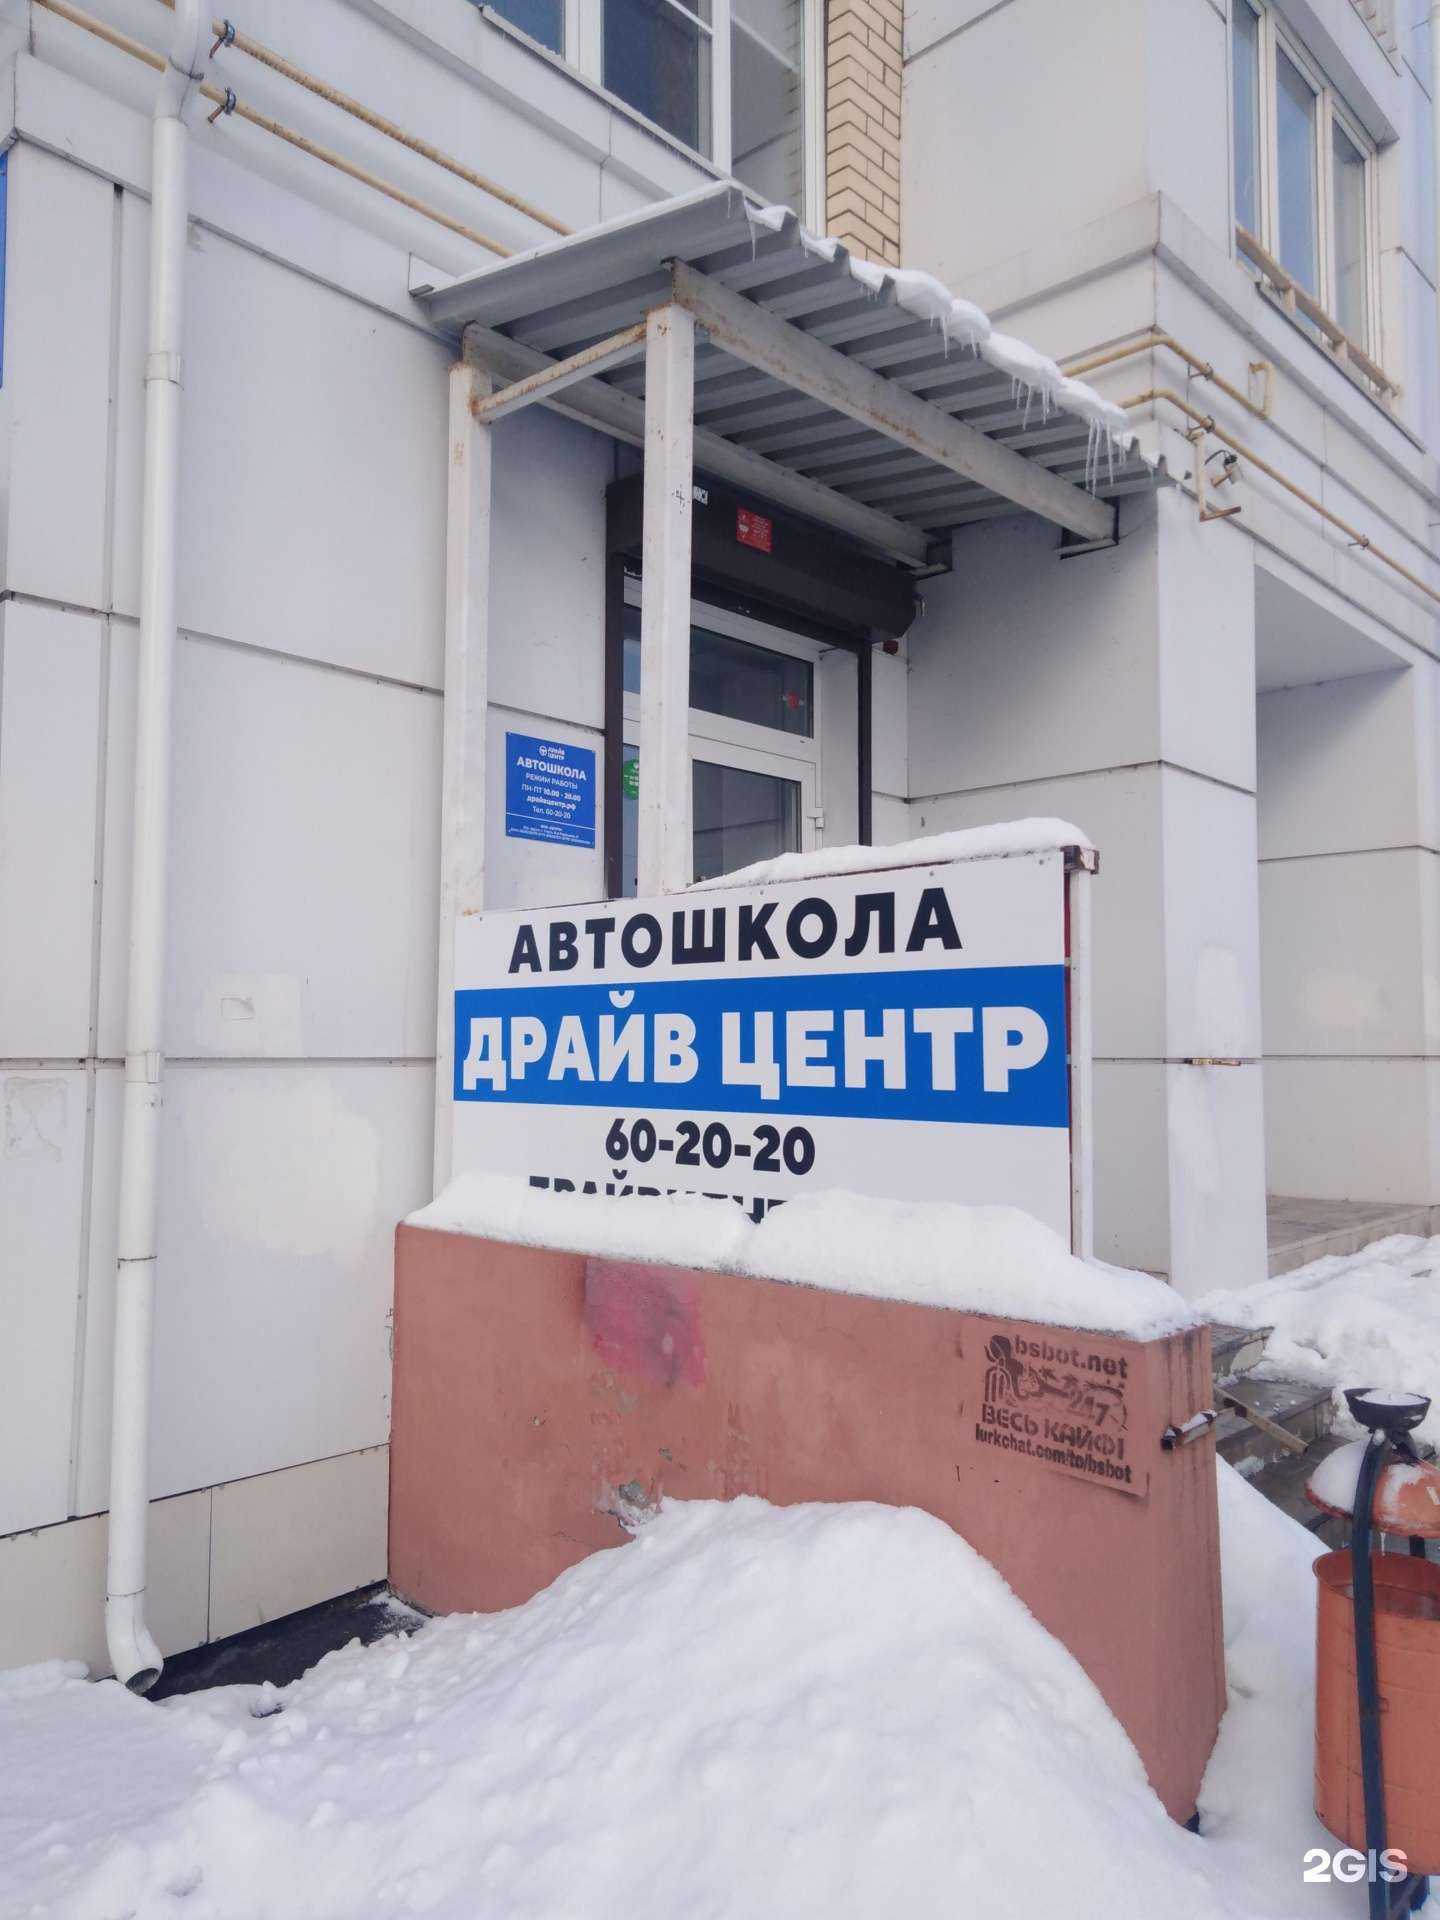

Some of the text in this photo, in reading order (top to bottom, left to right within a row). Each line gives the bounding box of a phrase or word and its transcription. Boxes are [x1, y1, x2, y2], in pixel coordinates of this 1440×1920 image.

[517, 756, 587, 781] АВТОШКОЛА
[526, 773, 578, 789] РЕЖИМ РАБОТЫ
[508, 886, 963, 974] АВТОШКОЛА
[462, 990, 1050, 1101] ДРАЙВ ЦЕНТР
[605, 1118, 816, 1176] 60-20-20
[1015, 1335, 1129, 1379] bsbot.net
